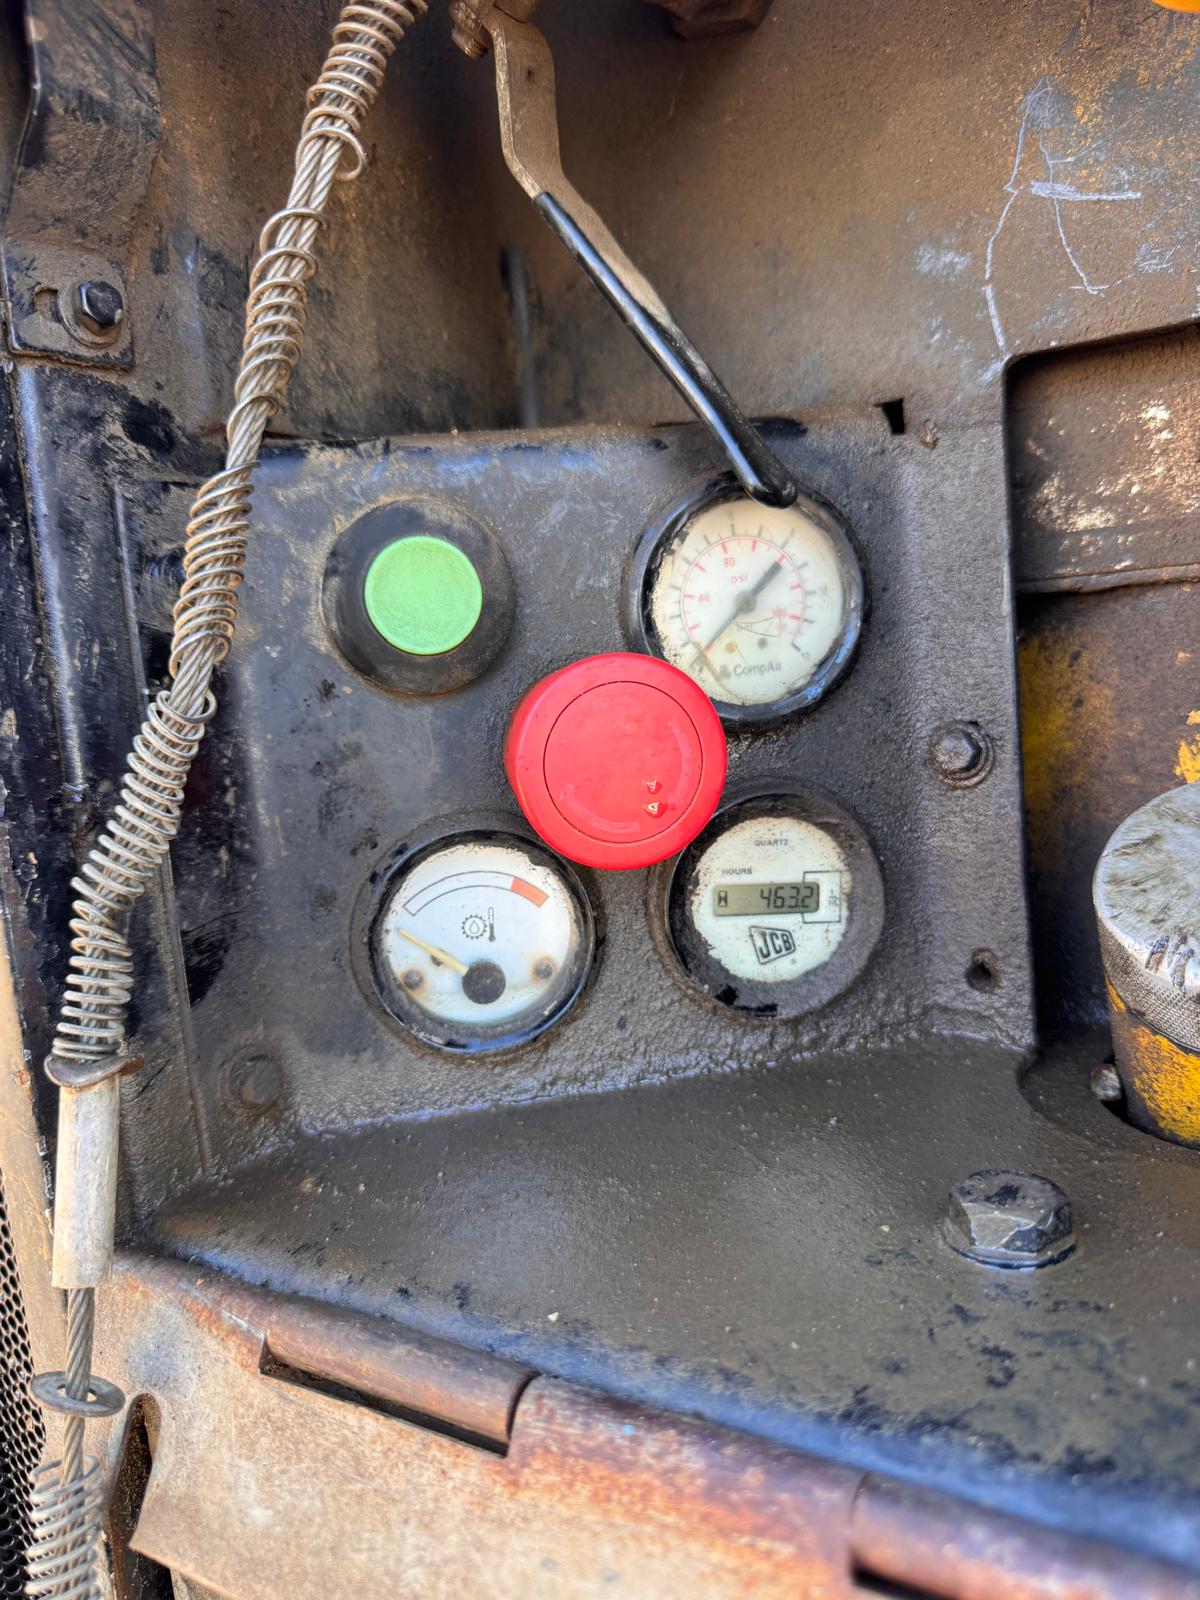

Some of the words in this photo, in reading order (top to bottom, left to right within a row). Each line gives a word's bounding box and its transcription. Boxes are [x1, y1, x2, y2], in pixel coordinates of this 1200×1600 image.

[733, 661, 783, 677] CompAir
[754, 839, 789, 847] QUARTZ
[722, 867, 752, 876] HOURS
[756, 928, 793, 959] JCB
